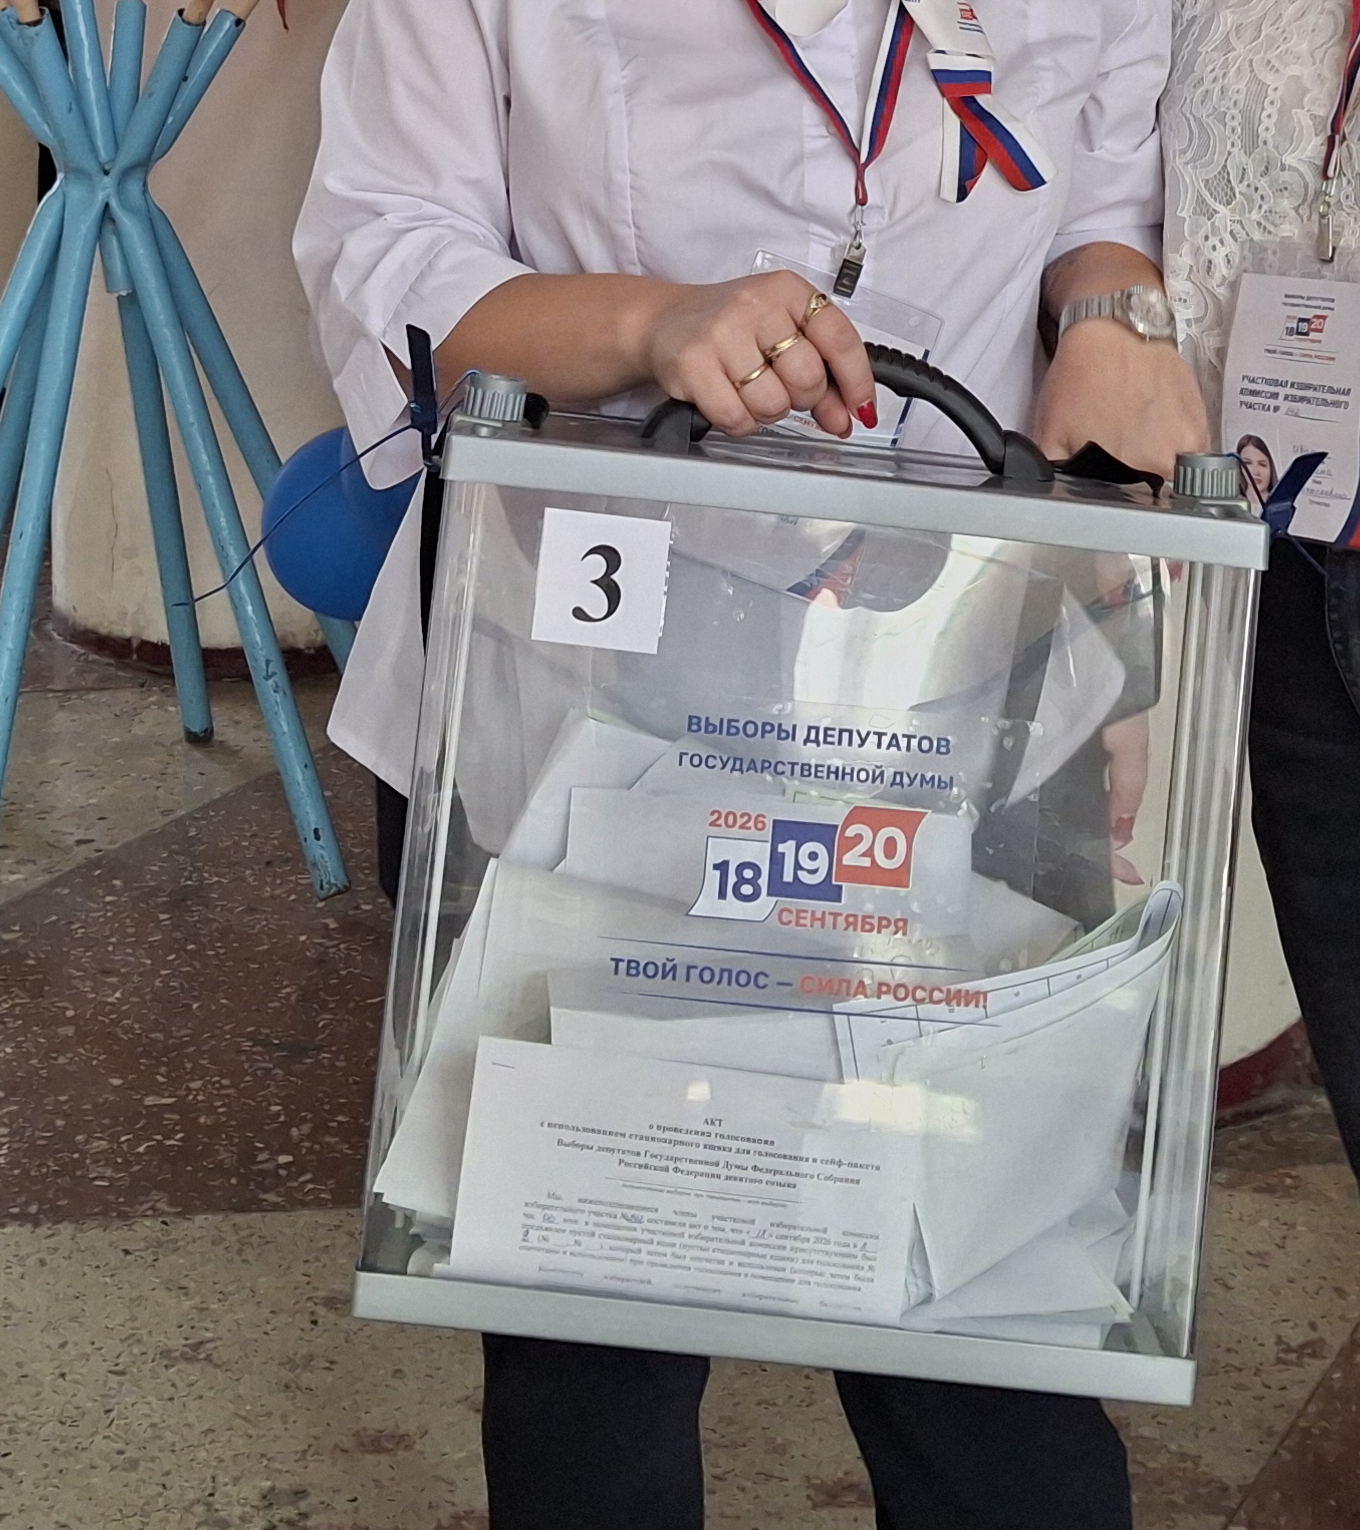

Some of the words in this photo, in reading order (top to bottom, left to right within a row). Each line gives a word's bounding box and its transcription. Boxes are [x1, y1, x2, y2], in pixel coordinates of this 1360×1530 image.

[1310, 318, 1324, 330] 20
[571, 543, 622, 623] 3
[686, 714, 798, 743] ВЫБОРЫ
[802, 724, 952, 757] ДЕПУТАТОВ
[677, 751, 886, 786] ГОСУДАРСТВЕННОЙ
[889, 770, 955, 792] ДУМЫ
[707, 808, 768, 832] 2026
[712, 858, 763, 904] 18
[776, 838, 831, 886] 19
[841, 822, 908, 870] 20
[776, 906, 909, 938] СЕНТЯБРЯ
[609, 956, 678, 983] ТВОЙ
[685, 964, 770, 991] ГОЛОС
[799, 974, 869, 1000] СИЛА
[876, 981, 989, 1010] РОССИИ!
[702, 1117, 724, 1128] АКТ
